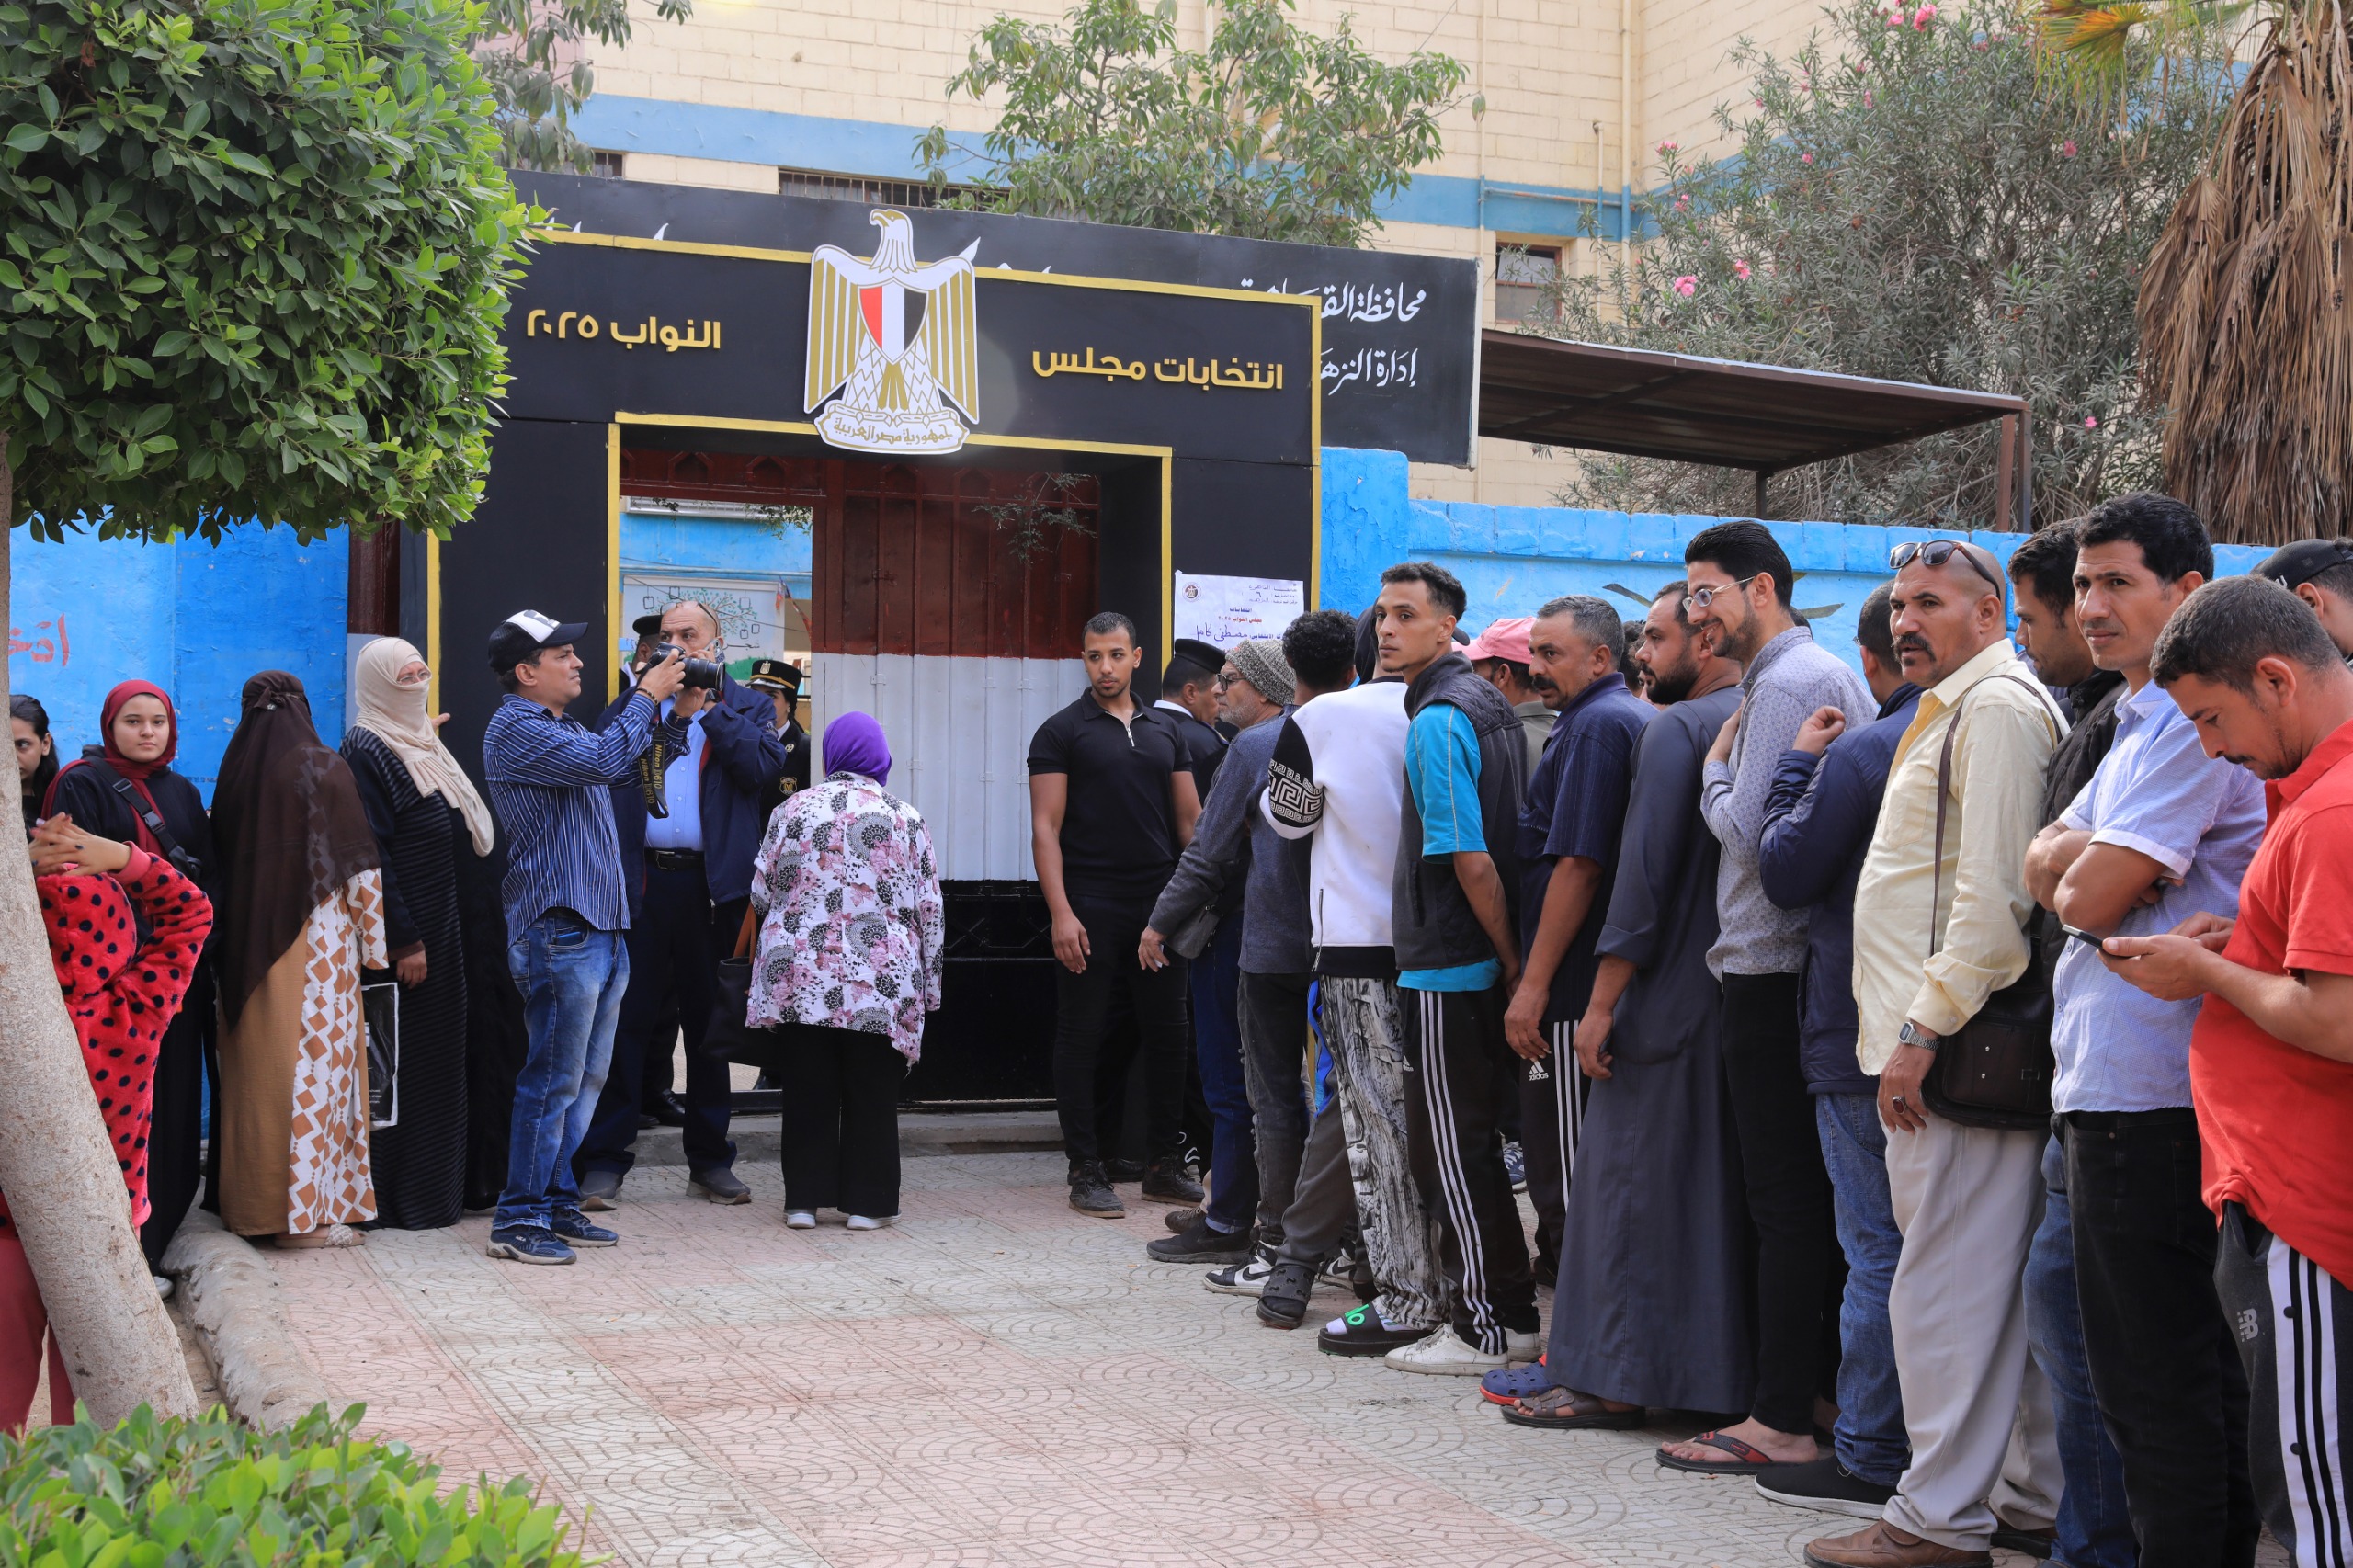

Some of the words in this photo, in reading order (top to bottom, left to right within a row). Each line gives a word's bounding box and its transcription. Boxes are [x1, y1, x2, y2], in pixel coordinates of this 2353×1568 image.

[1349, 281, 1427, 323] محافظة
[527, 308, 599, 339] ٢٠٢٥
[610, 315, 721, 353] النواب
[1032, 347, 1147, 382] مجلس
[1154, 357, 1284, 392] انتخابات
[1321, 347, 1373, 396] النزه
[834, 416, 875, 442] العربية
[872, 431, 902, 444] مصر
[904, 424, 954, 445] جمهورية
[654, 744, 663, 767] Nikon
[640, 758, 650, 782] Nikon
[653, 768, 663, 790] D610
[643, 783, 655, 804] D610
[1528, 1072, 1550, 1081] adidas
